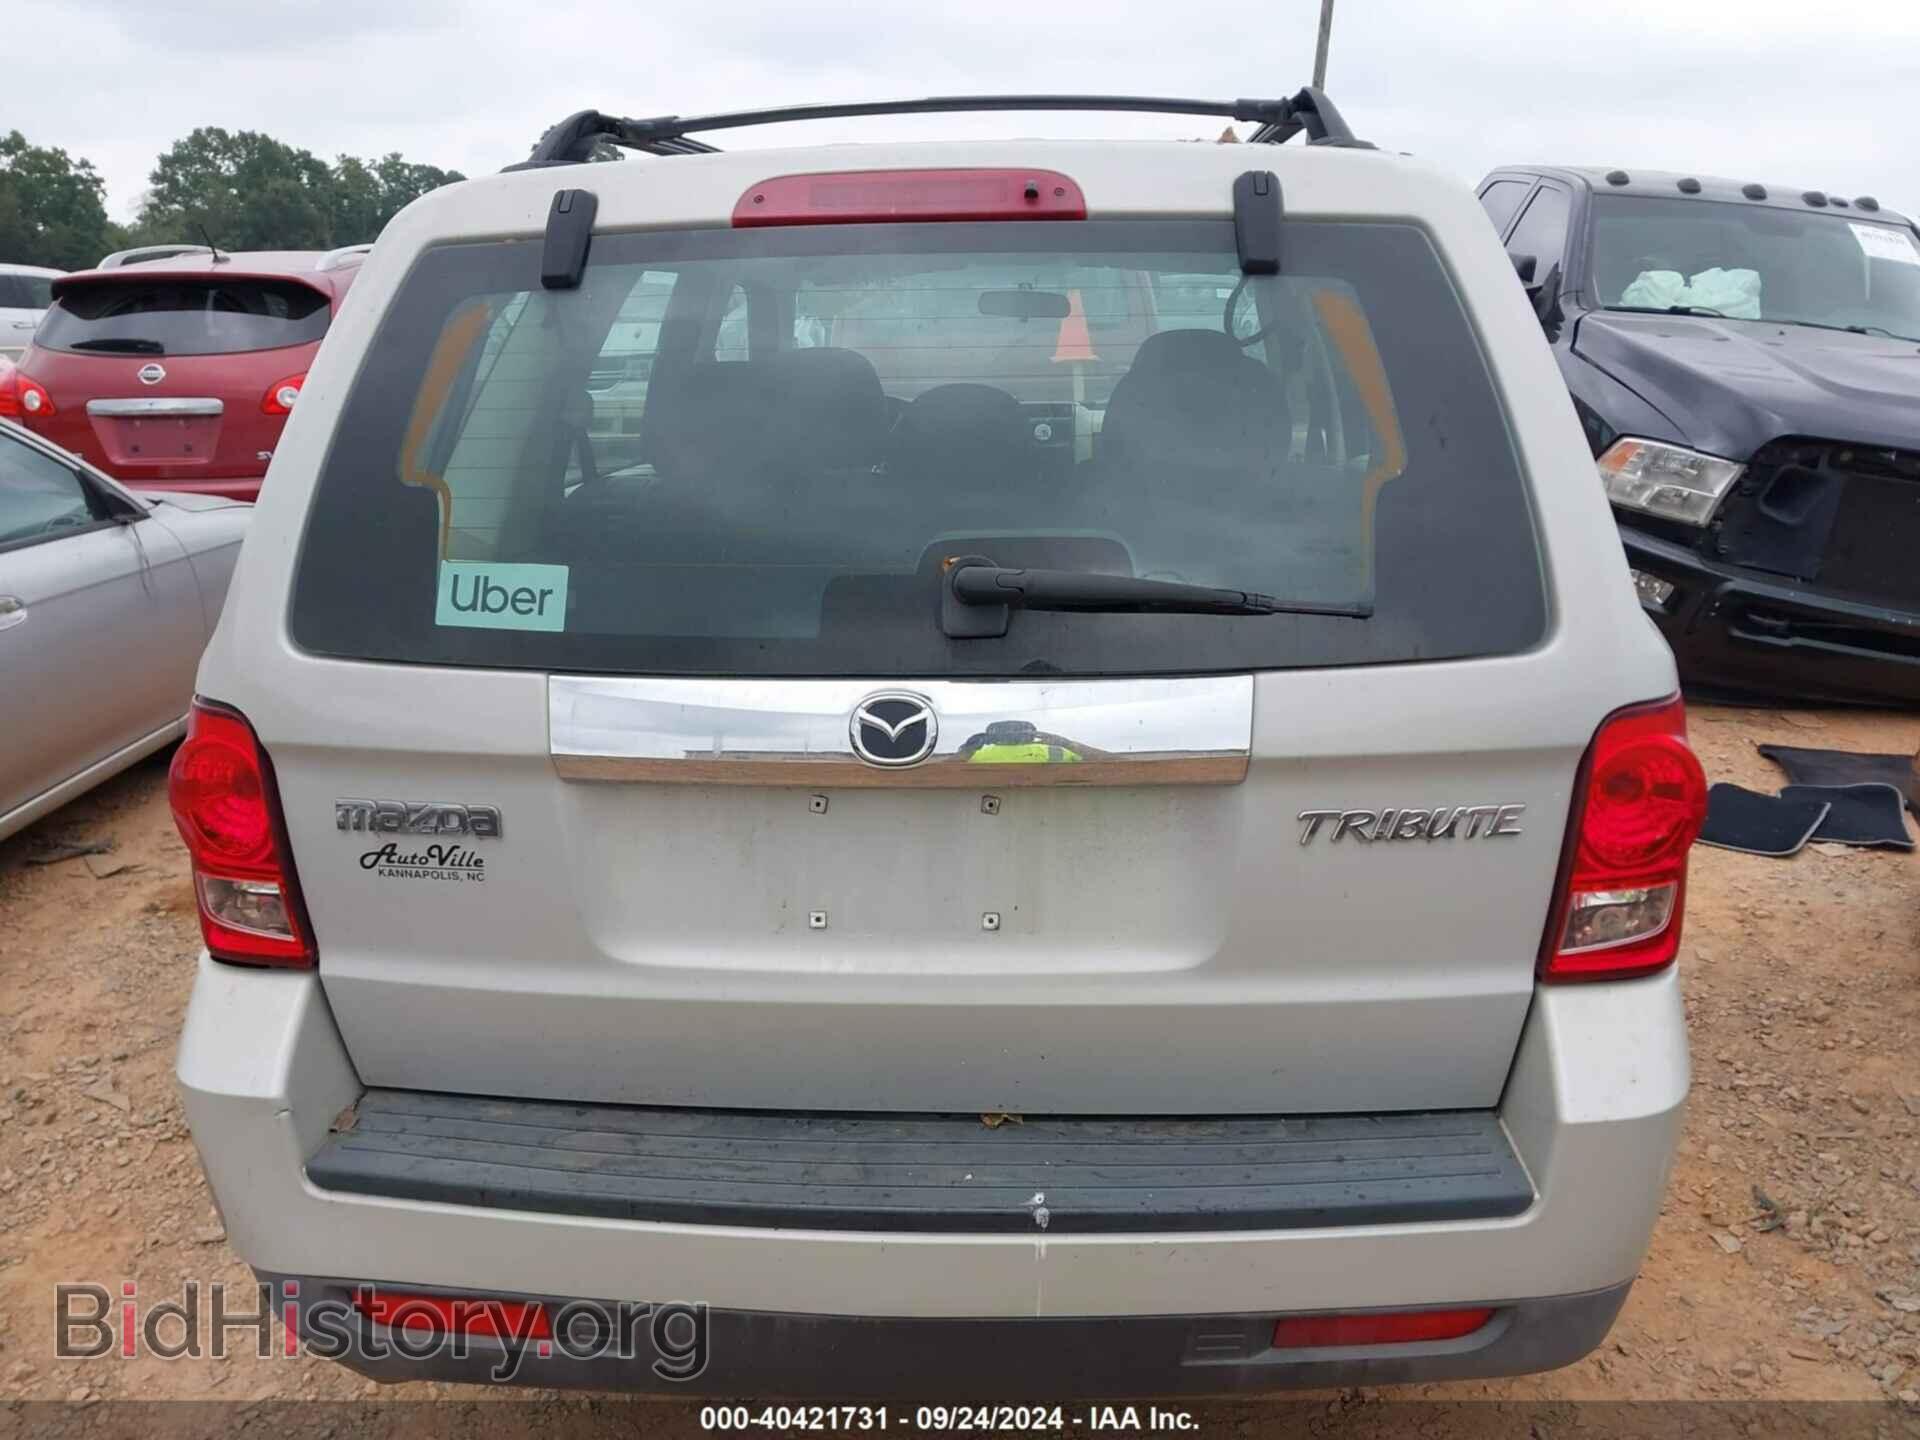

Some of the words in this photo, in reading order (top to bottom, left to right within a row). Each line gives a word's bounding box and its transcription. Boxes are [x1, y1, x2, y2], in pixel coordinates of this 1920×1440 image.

[450, 574, 553, 616] Uber
[1298, 802, 1526, 845] TRIBUTE
[377, 867, 464, 882] KANNAPOLIS,
[467, 872, 486, 882] NC
